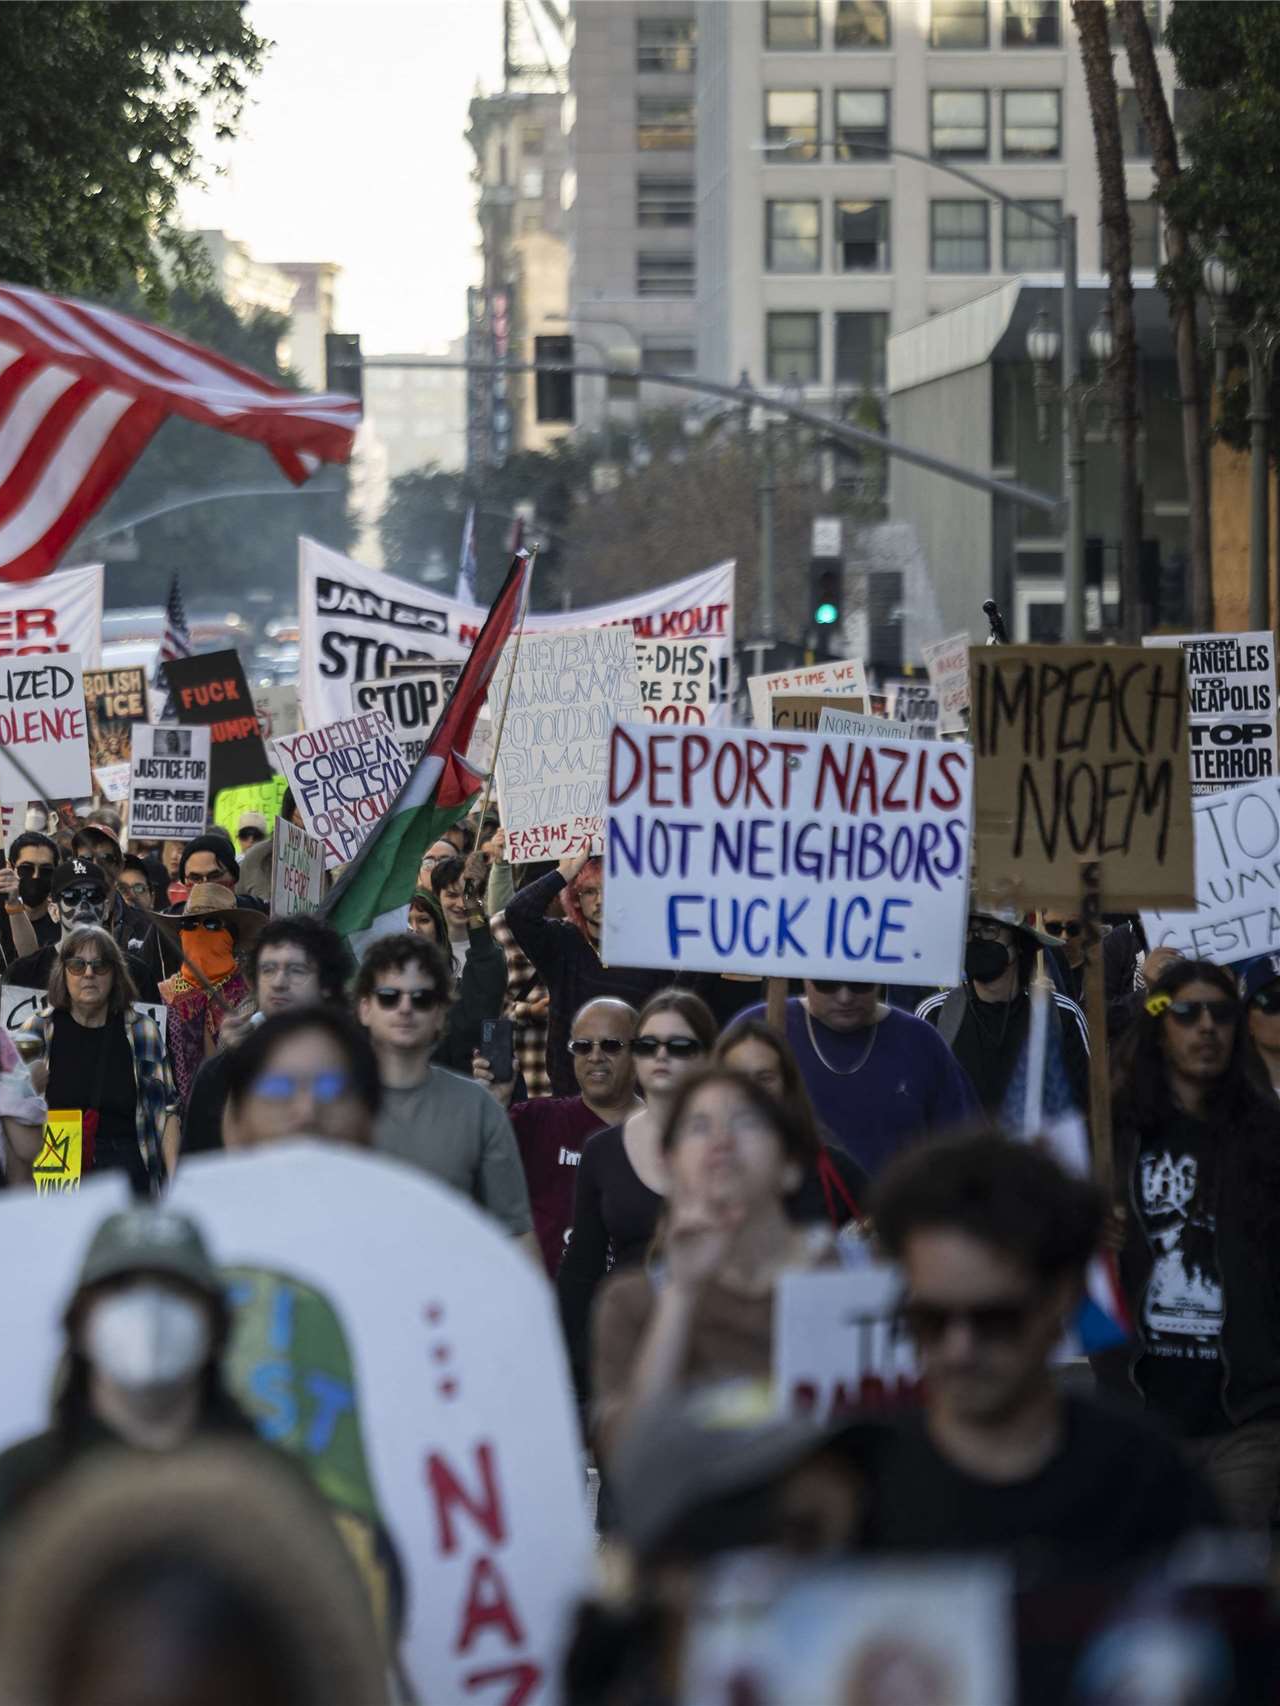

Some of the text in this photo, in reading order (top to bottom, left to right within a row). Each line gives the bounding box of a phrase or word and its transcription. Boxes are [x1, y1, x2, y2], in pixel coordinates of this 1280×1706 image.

[319, 584, 446, 634] JAN 20
[794, 671, 826, 687] TIME
[833, 665, 854, 681] WE
[1189, 644, 1270, 674] ANGELES
[181, 679, 240, 709] FUCK
[672, 681, 701, 704] IS
[1197, 679, 1224, 689] TO
[104, 695, 144, 719] ICE
[358, 680, 438, 729] STOP
[975, 658, 1188, 760] IMPEACH
[279, 709, 395, 763] YOU EITHER
[1188, 723, 1273, 747] TOP
[134, 759, 206, 780] JUSTICE FOR
[293, 735, 402, 786] CONDEM
[608, 725, 968, 816] DEPORT NAZIS
[1190, 748, 1273, 779] TERROR
[134, 788, 205, 801] RENEE
[300, 758, 411, 817] FACISM
[132, 804, 203, 823] NICOLE GOOD
[312, 794, 390, 837] OR YOU
[1012, 757, 1173, 866] NOEM
[608, 816, 703, 879] NOT
[666, 893, 809, 960] FUCK
